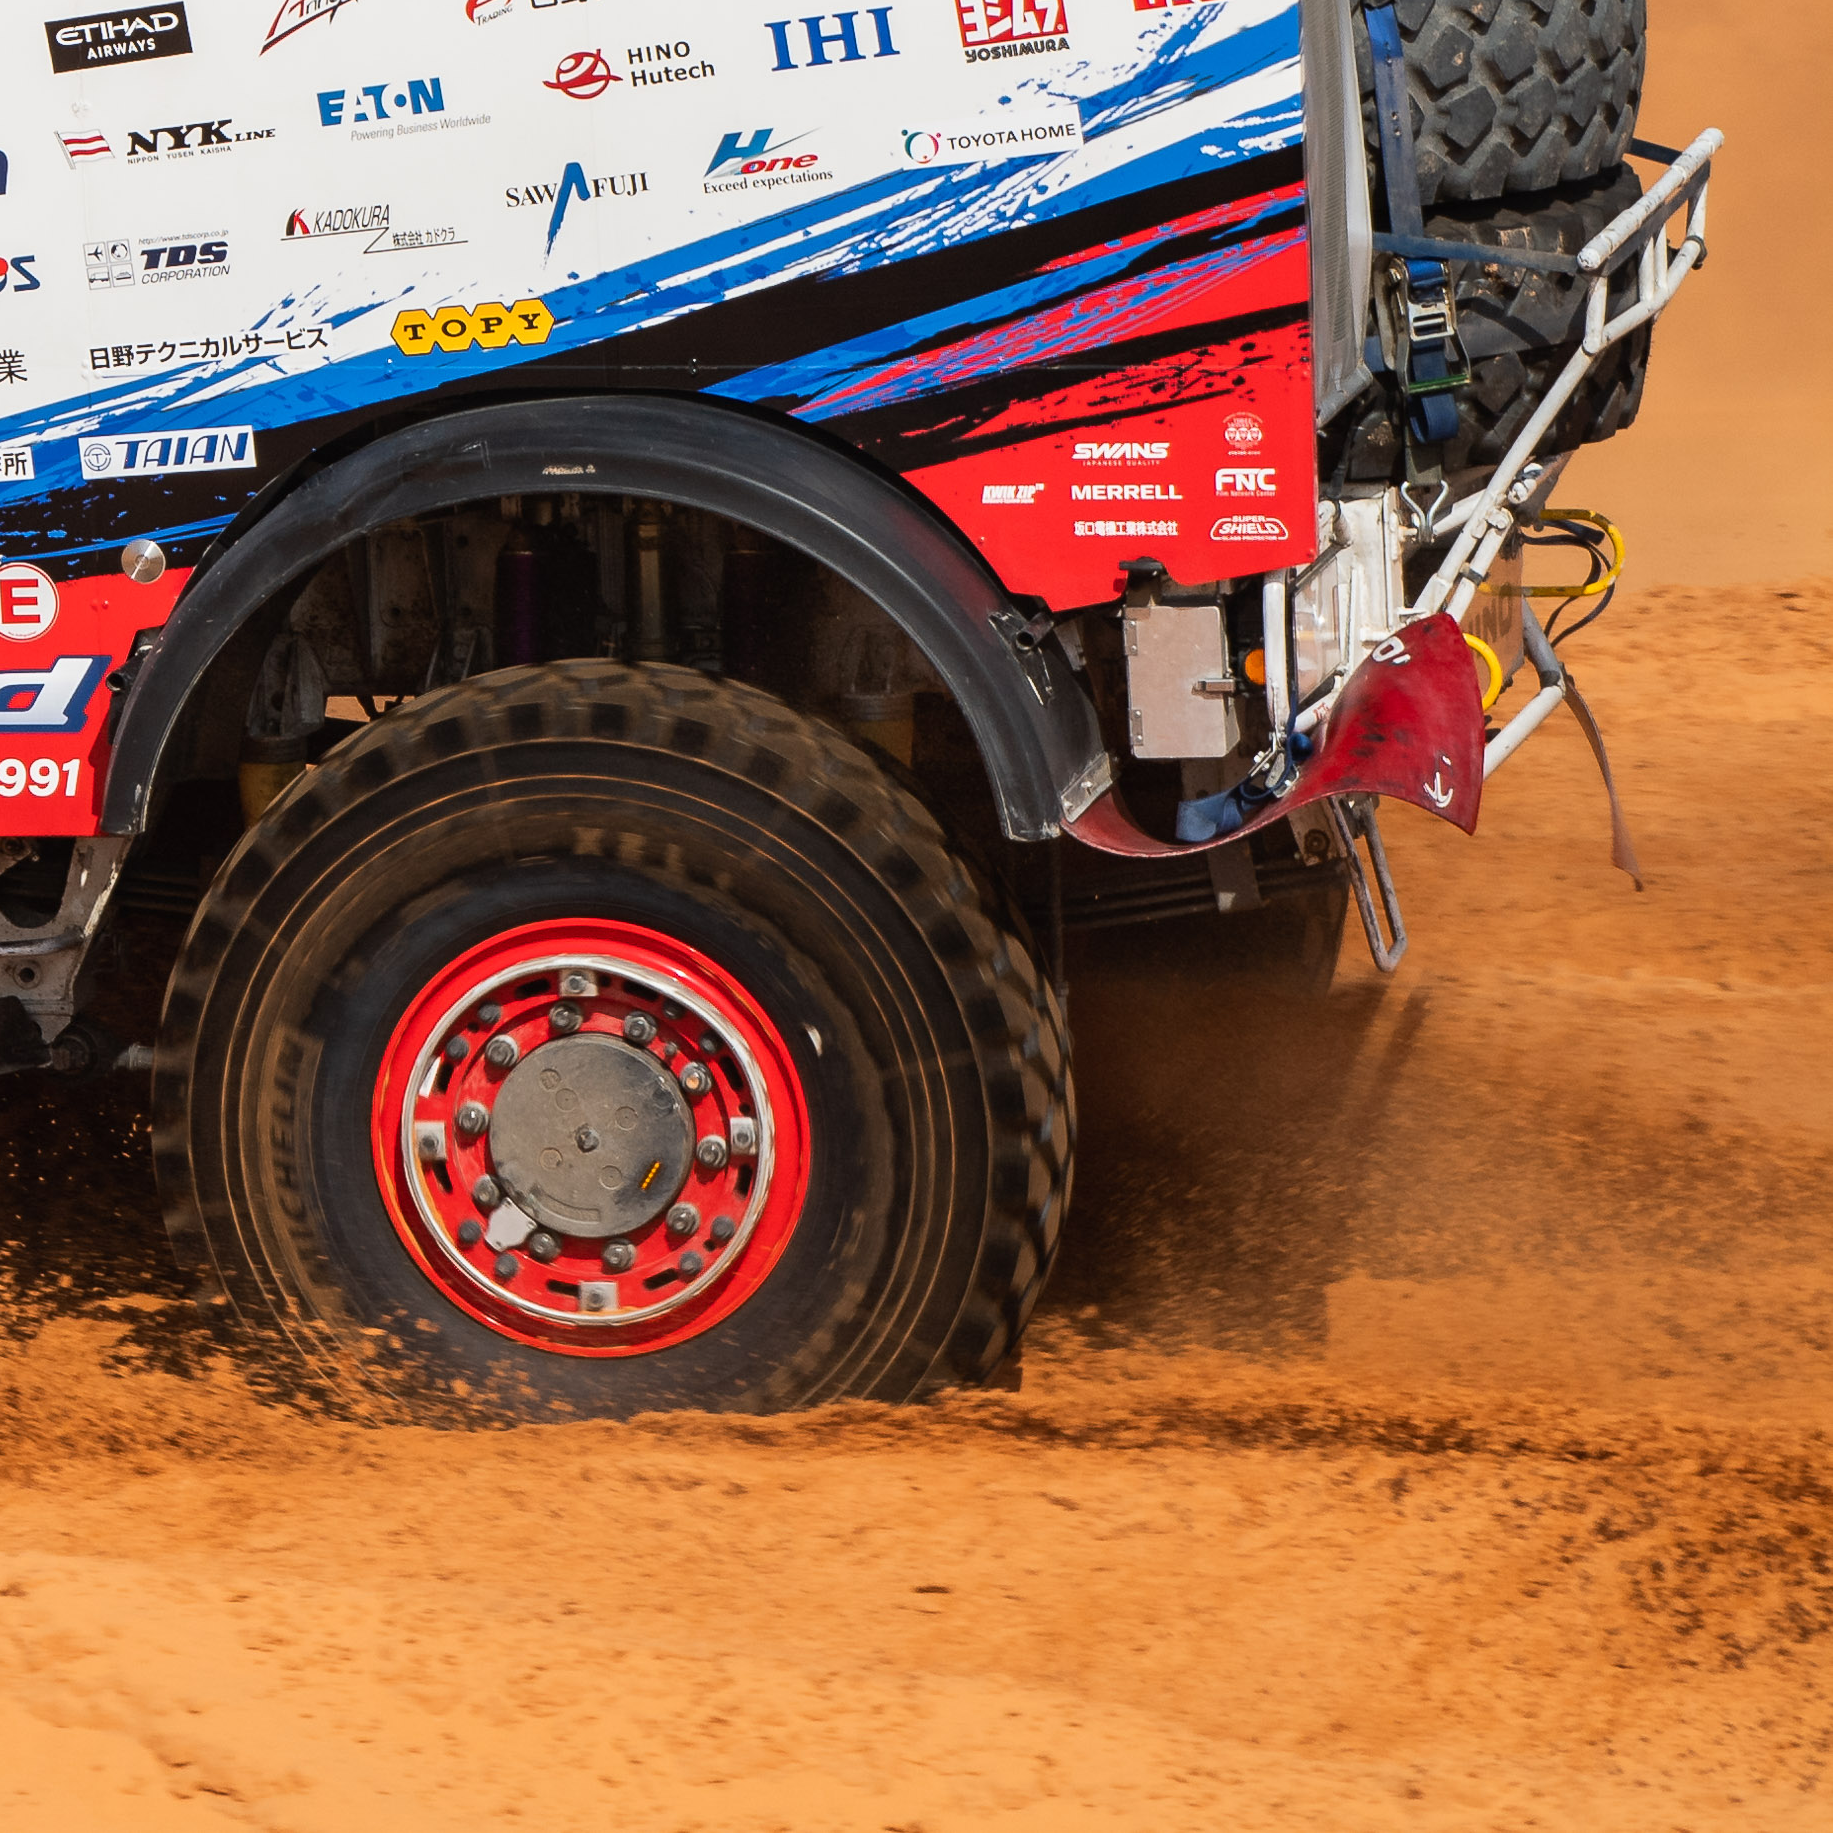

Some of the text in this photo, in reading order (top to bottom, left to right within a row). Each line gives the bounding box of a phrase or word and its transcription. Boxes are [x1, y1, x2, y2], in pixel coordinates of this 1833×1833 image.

[55, 11, 179, 48] ETIHAD
[763, 5, 901, 73] IHI
[86, 36, 157, 61] AIRWAYS
[627, 40, 692, 65] HINO
[963, 36, 1071, 64] YOSHIMURA
[630, 59, 717, 88] Hutech
[126, 117, 277, 158] NYK LINE
[350, 113, 492, 143] Powering Business Worldwide
[946, 122, 1077, 152] TOYOTA HOME
[127, 145, 233, 166] NIPPON YUSEN KAISHA
[702, 168, 833, 195] Exceed expectations
[312, 203, 391, 235] KADOKURA
[139, 239, 231, 271] TDS
[141, 264, 232, 286] CORPORATION
[403, 311, 541, 343] TOPY
[89, 326, 330, 371] 日野テクニカルサービス
[113, 431, 249, 470] TAIAN
[1071, 441, 1171, 460] SWANS
[1071, 483, 1183, 501] MERRELL
[1214, 467, 1277, 492] FNC
[1217, 522, 1281, 535] SHIELD
[0, 578, 41, 624] E
